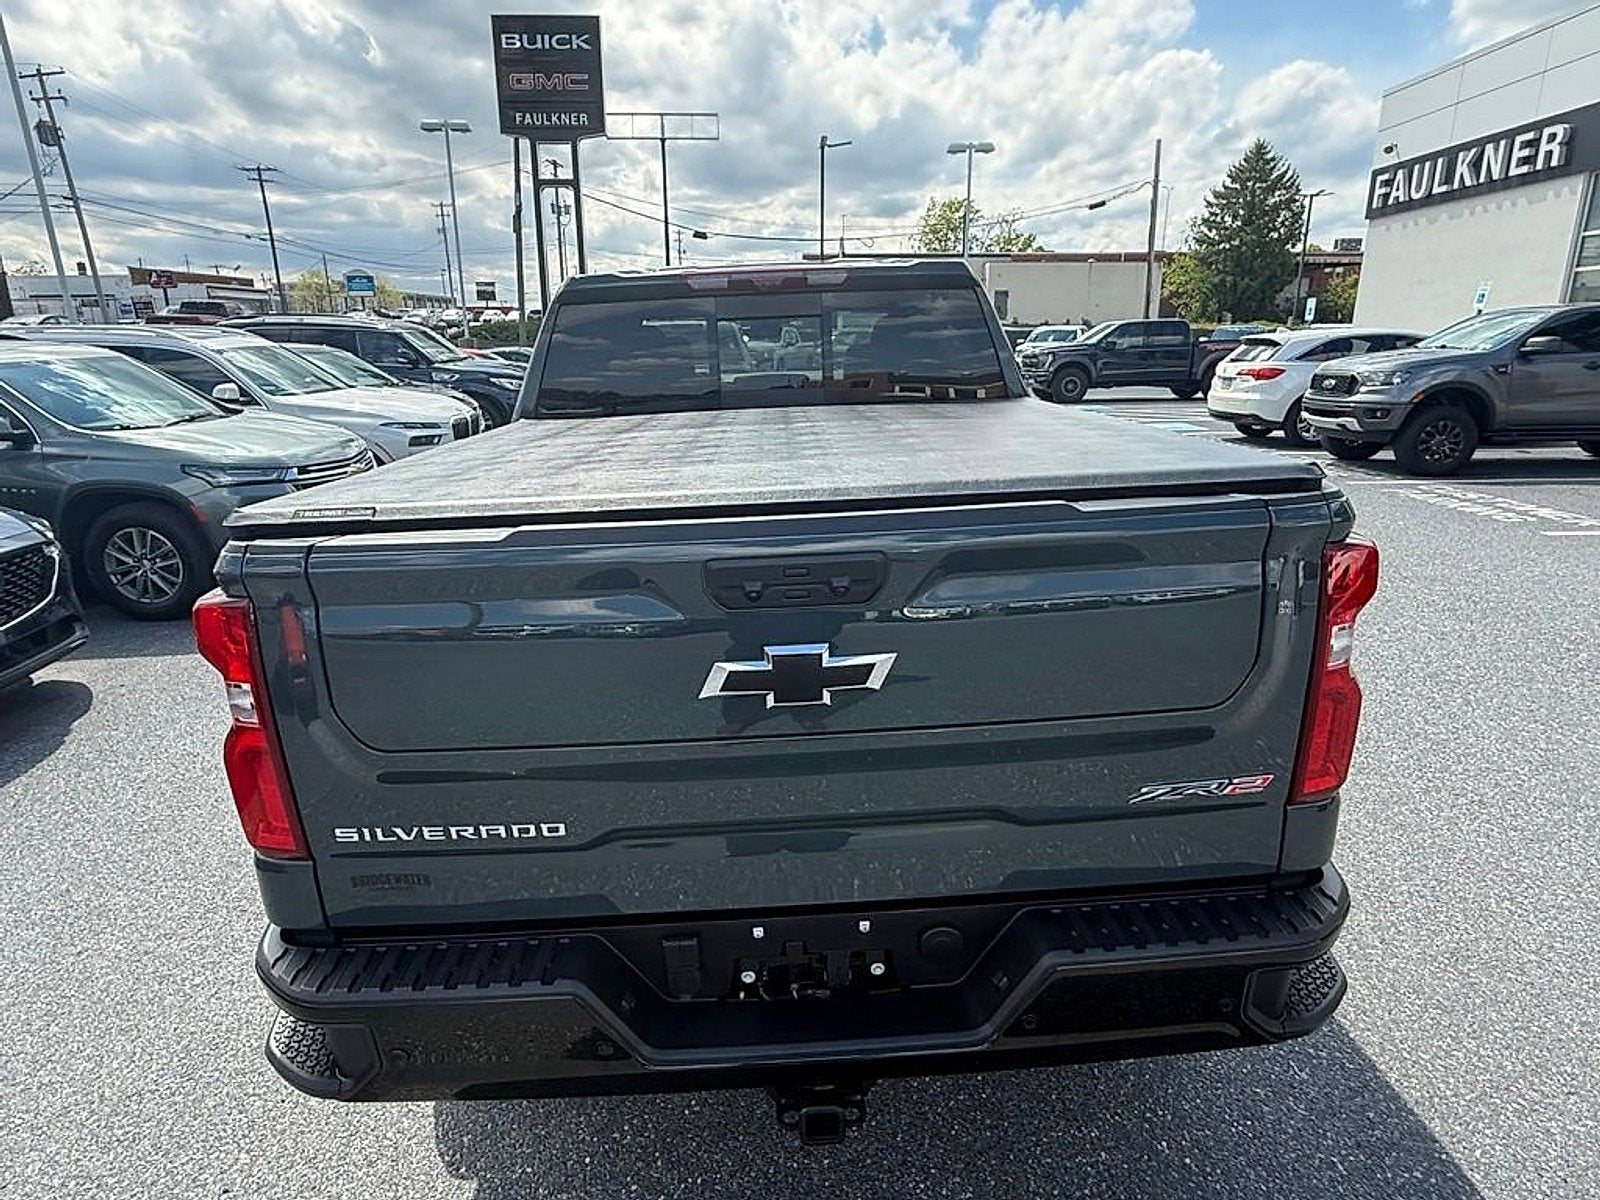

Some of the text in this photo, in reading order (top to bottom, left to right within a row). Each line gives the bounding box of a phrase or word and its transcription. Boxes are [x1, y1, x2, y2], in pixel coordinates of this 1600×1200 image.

[500, 33, 592, 50] BUICK
[509, 73, 589, 91] GMC
[515, 112, 589, 126] FAULKNER
[1371, 123, 1573, 209] FAULKNER
[1127, 774, 1275, 805] ZR2
[334, 823, 567, 842] SILVERADO
